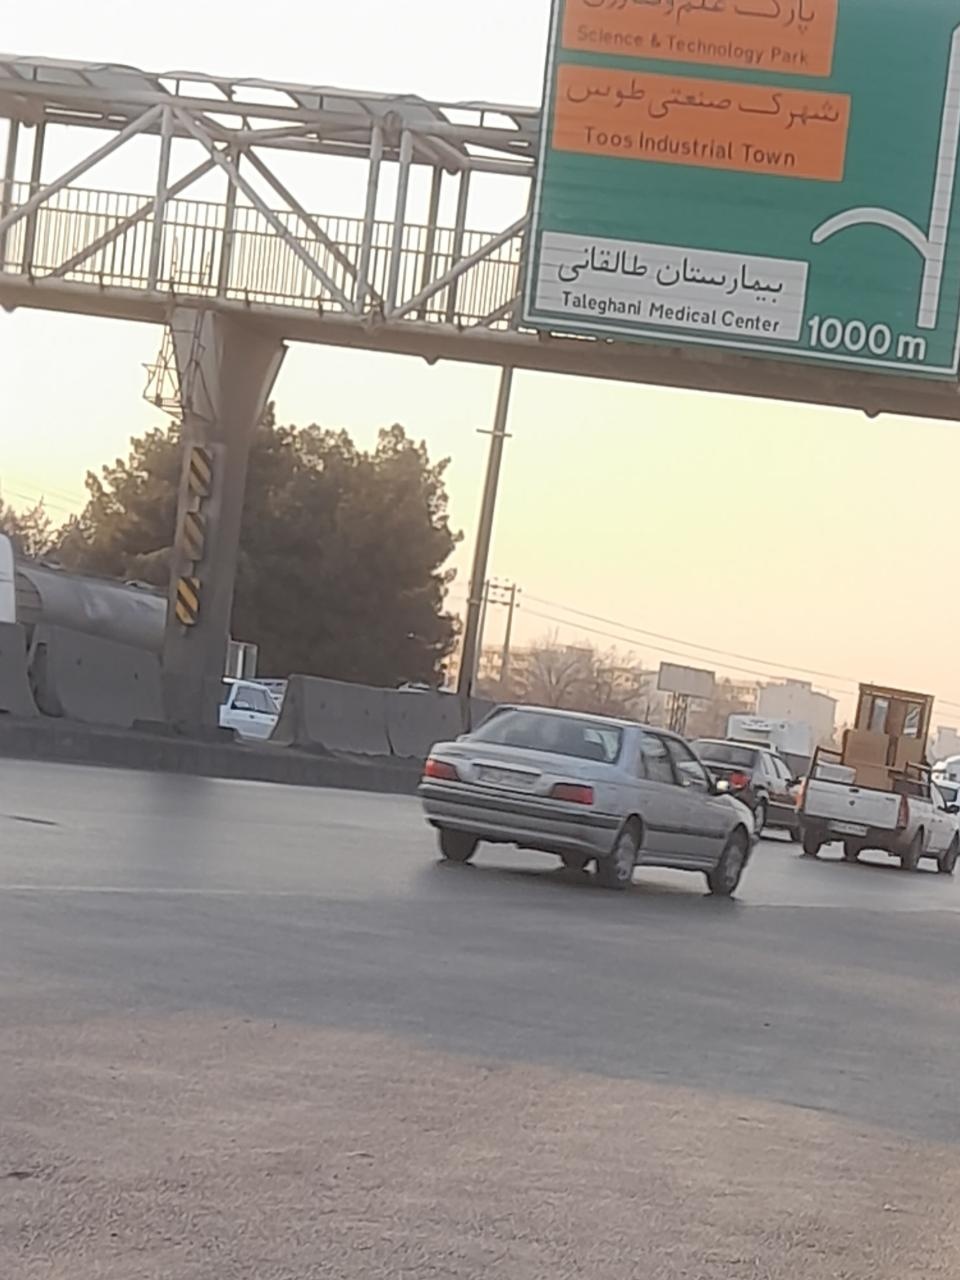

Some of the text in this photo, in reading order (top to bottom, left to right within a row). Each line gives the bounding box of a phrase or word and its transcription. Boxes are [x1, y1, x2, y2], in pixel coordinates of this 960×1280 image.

[734, 0, 816, 35] پارک
[577, 24, 809, 65] Science & Technology Park
[566, 78, 839, 130] شهرک صنعتی طوس
[584, 126, 796, 167] Toos Industrial Town
[557, 246, 783, 304] بیمارستان طالقانی
[561, 290, 781, 333] Taleghani Medical Center
[807, 315, 927, 361] 1000 m
